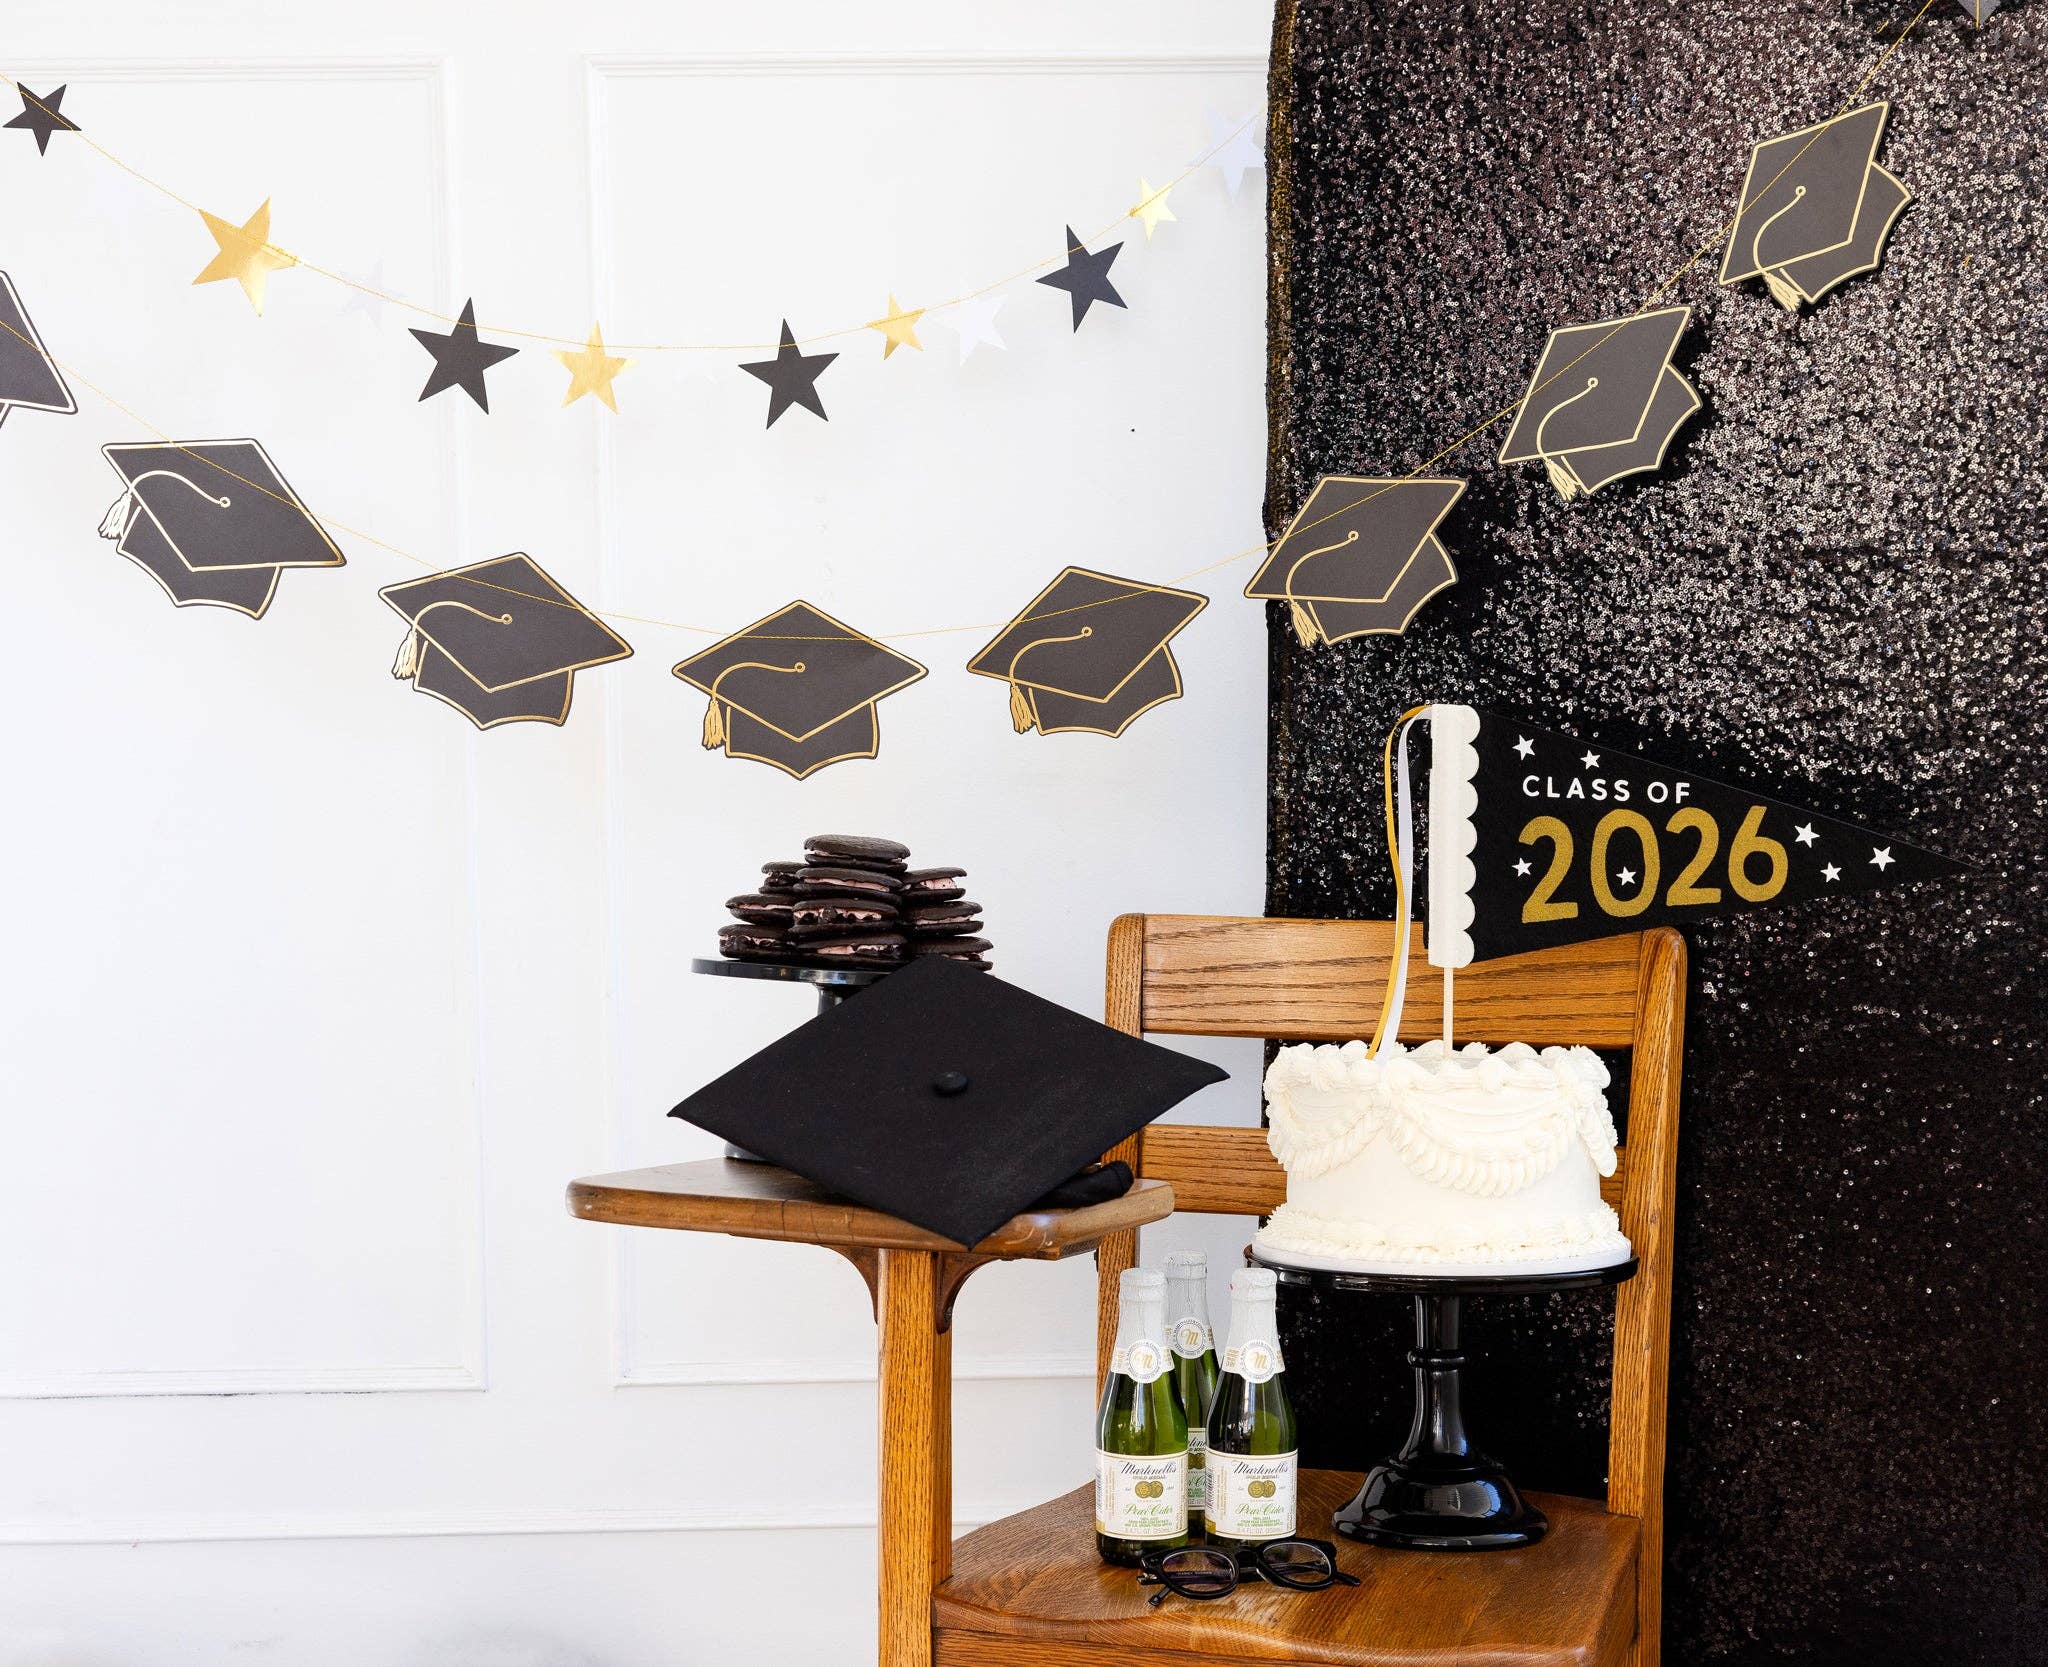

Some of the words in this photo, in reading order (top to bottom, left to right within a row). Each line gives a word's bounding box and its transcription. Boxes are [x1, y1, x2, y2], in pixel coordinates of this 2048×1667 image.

[1522, 774, 1630, 802] CLASS
[1647, 781, 1690, 804] OF
[1518, 805, 1789, 924] 2026
